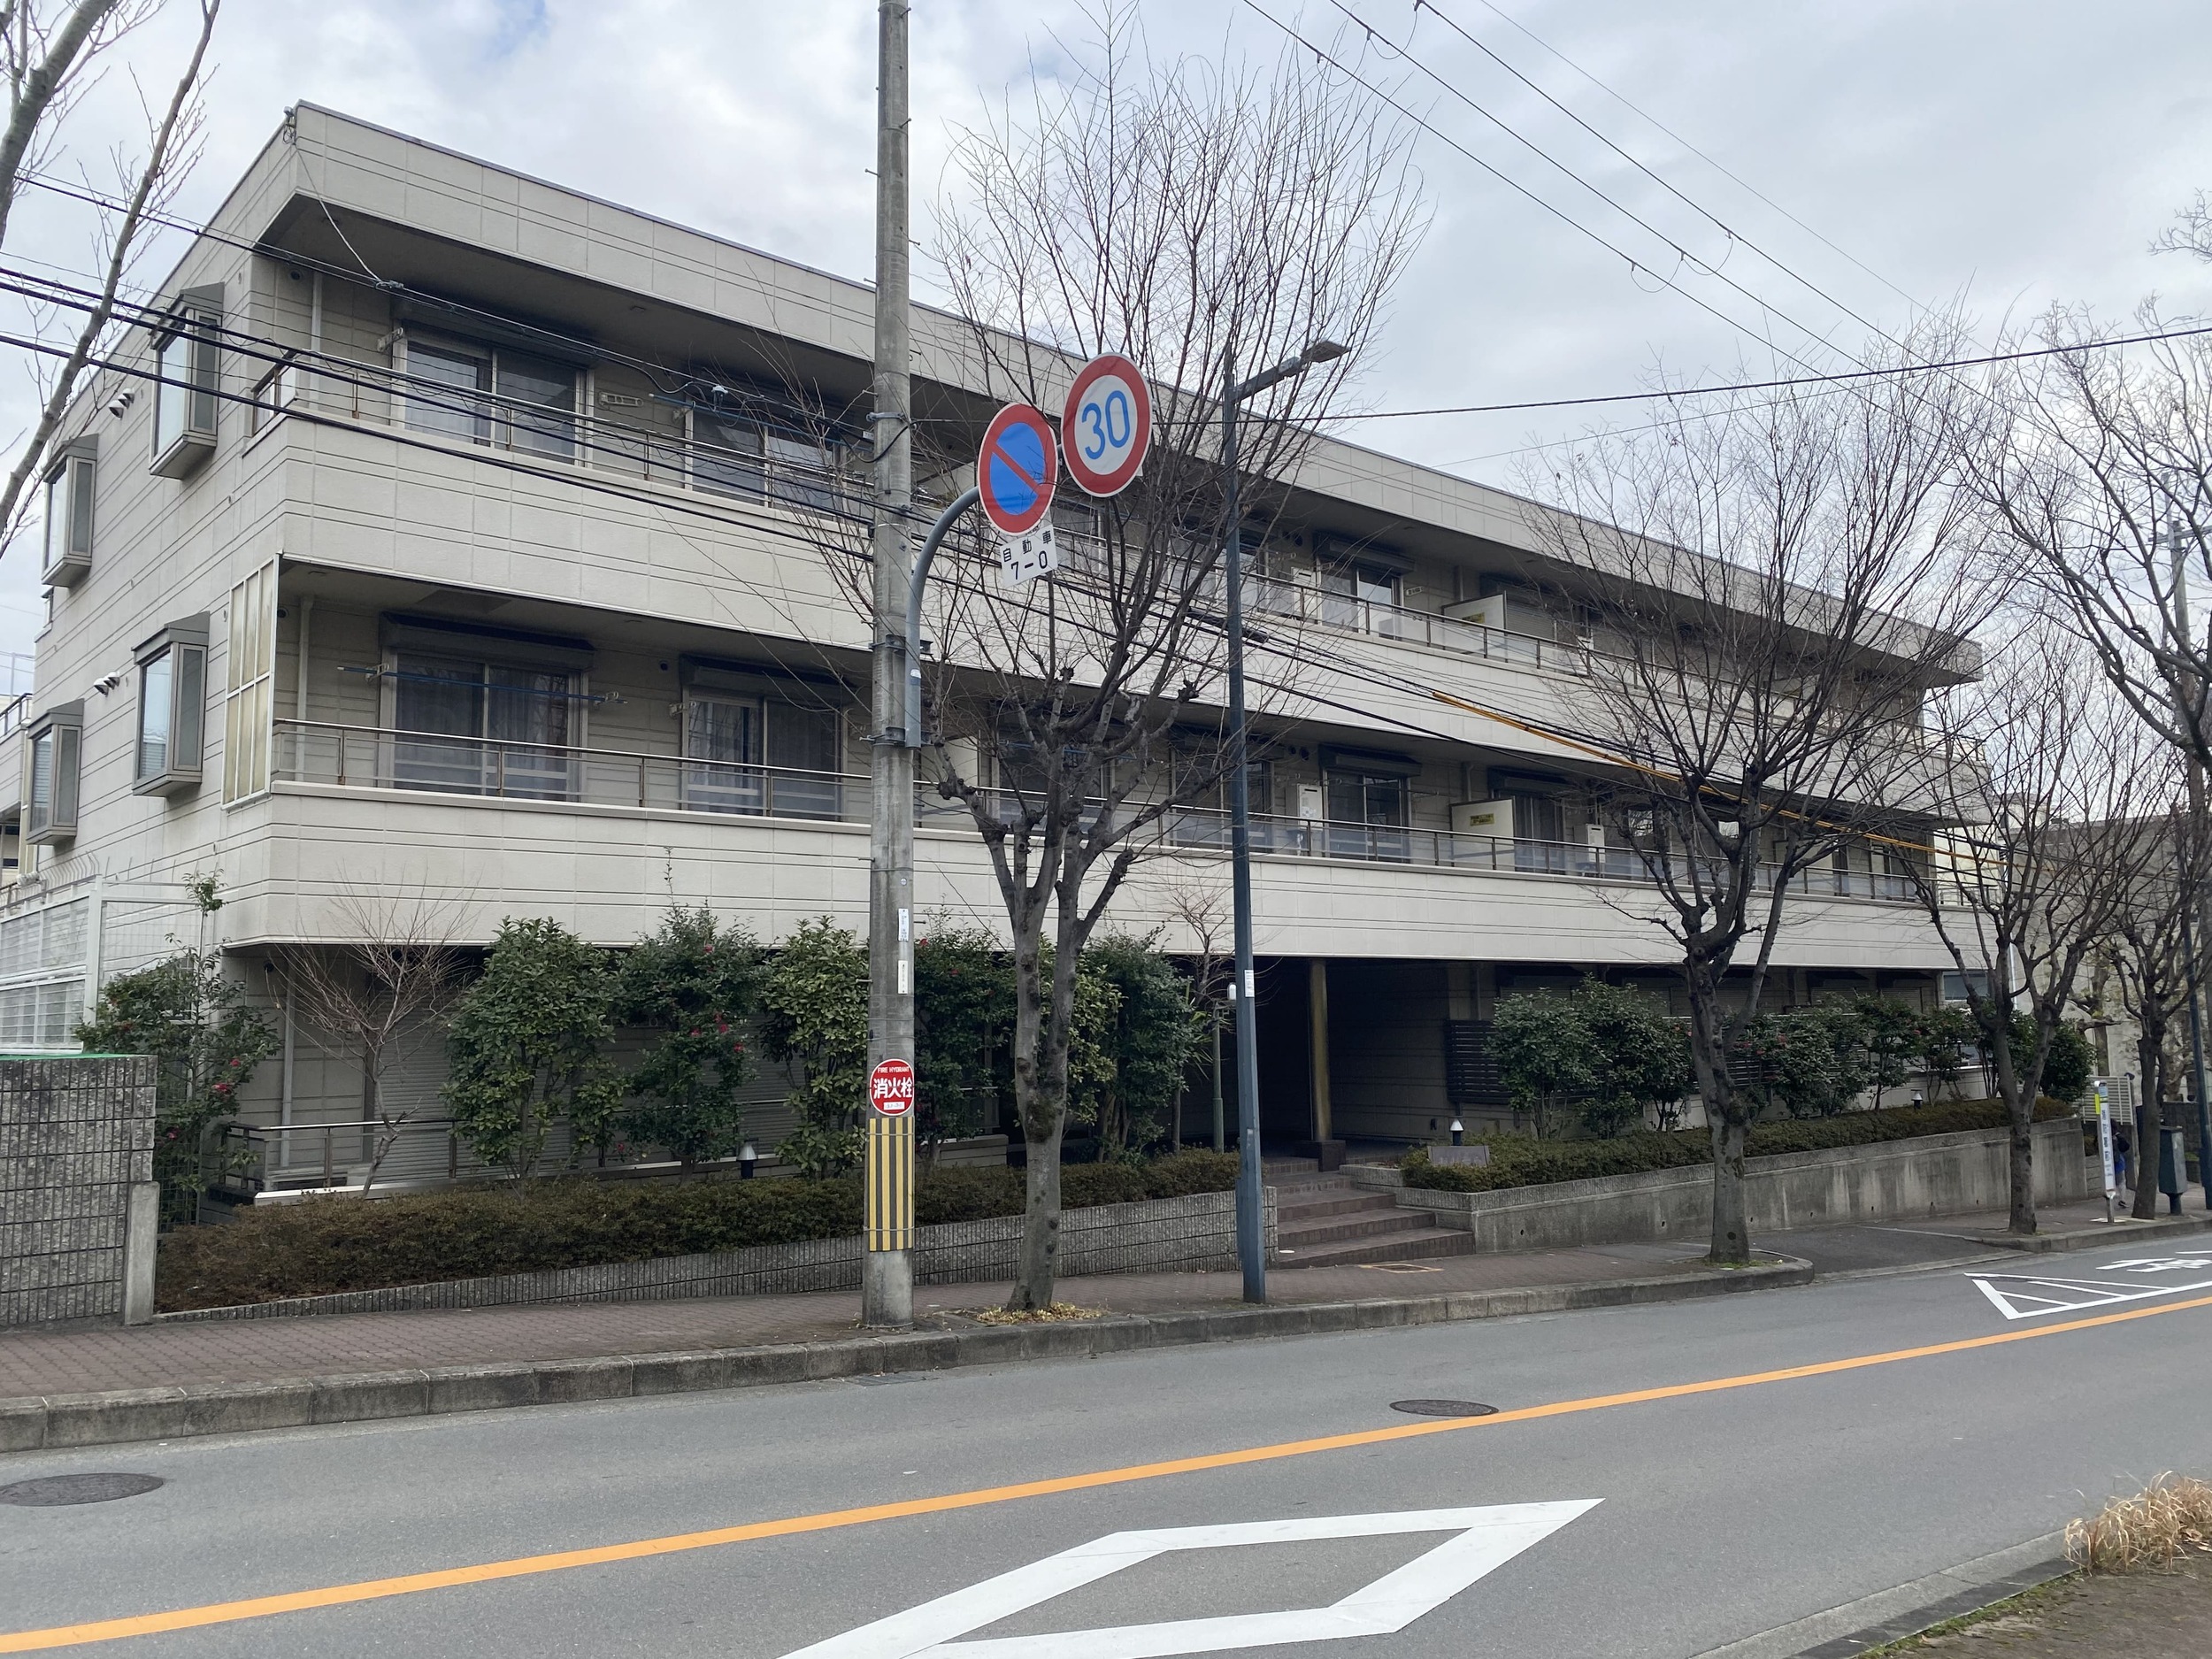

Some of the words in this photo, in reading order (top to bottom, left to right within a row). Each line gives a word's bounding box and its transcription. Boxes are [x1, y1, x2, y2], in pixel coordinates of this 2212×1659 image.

[1081, 390, 1130, 460] 30
[1002, 531, 1052, 563] 自動車
[1010, 550, 1048, 580] 7-0
[873, 1077, 913, 1099] 消火栓
